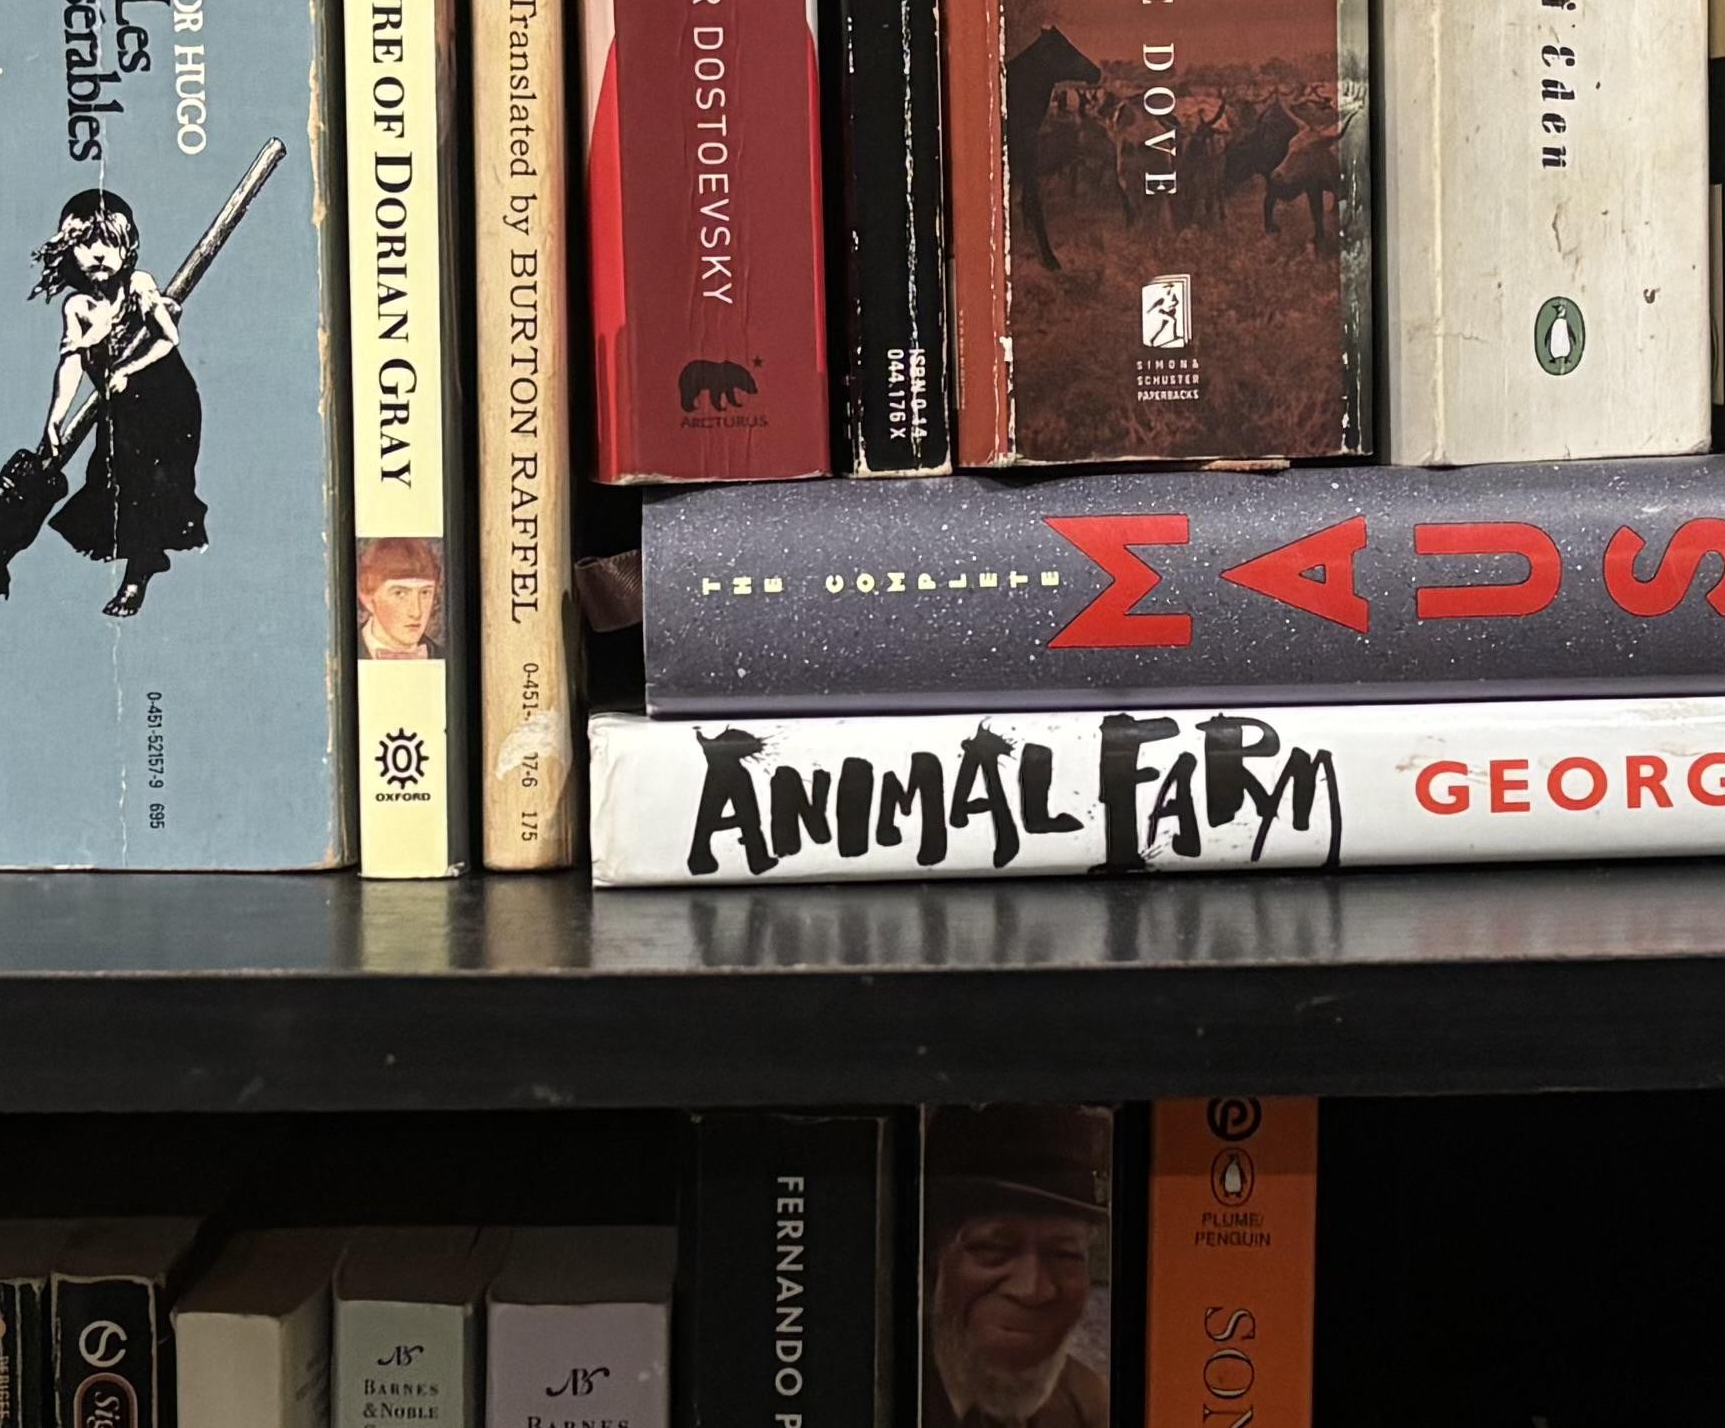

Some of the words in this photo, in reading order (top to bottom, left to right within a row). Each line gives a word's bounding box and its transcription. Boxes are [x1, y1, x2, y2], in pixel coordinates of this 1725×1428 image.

[173, 44, 207, 155] HUGO
[372, 75, 406, 139] OF
[693, 26, 733, 304] DOSTOEVSKY
[1142, 42, 1177, 195] DOVE
[374, 151, 414, 343] DORIAN
[378, 357, 418, 489] GRAY
[374, 792, 432, 803] OXFORD
[685, 718, 1085, 877] ANIMAL
[774, 1176, 805, 1397] FERNANDO
